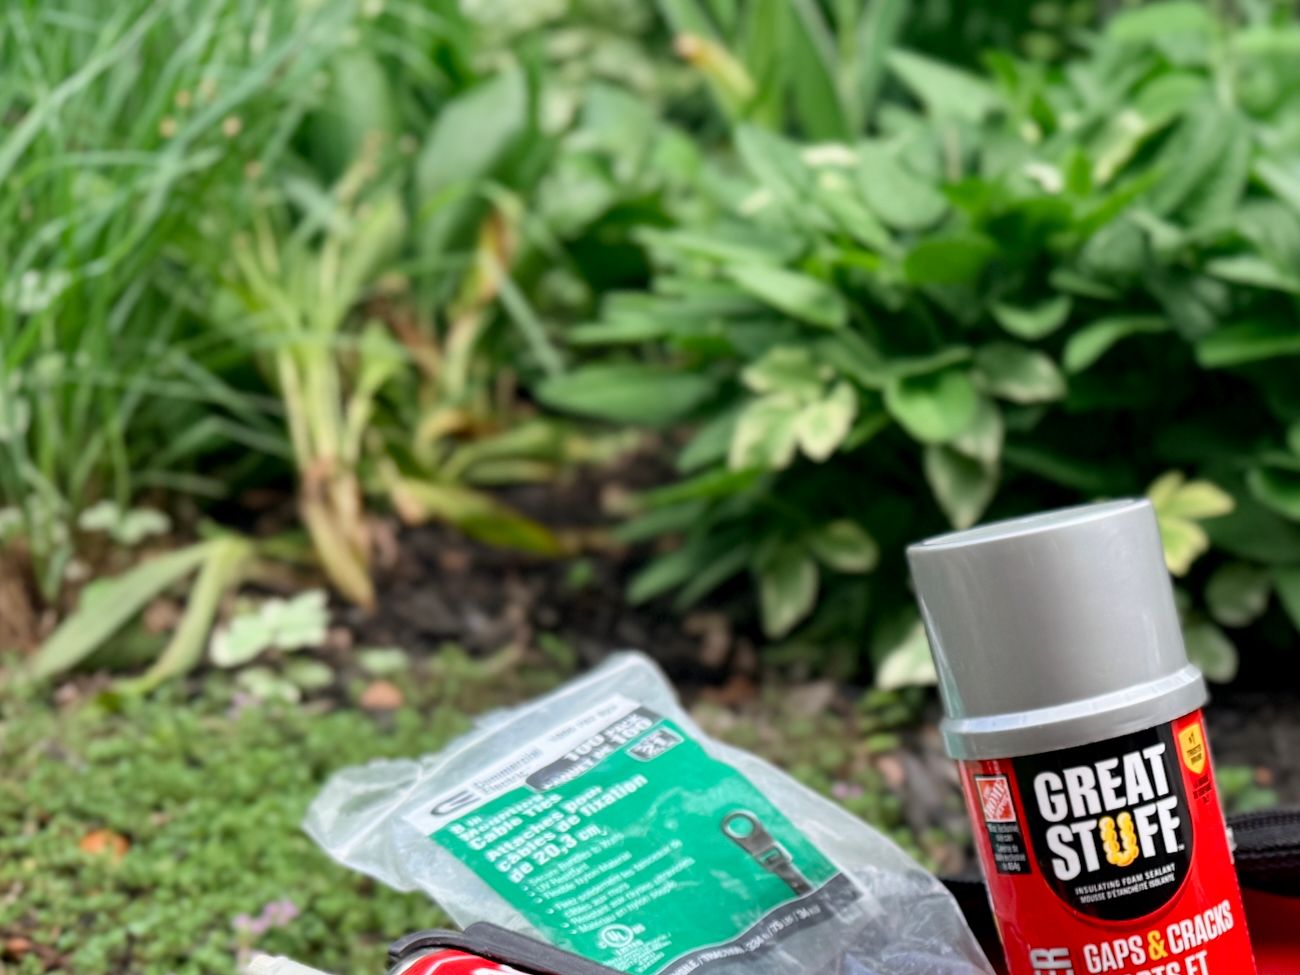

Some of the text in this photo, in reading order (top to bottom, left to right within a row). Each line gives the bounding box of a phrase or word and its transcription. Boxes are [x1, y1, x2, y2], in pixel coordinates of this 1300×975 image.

[554, 813, 581, 831] de
[579, 774, 648, 817] fixation
[1033, 743, 1169, 822] GREAT
[468, 792, 563, 850] Cable Ties
[484, 785, 605, 860] Attaches pour
[1045, 796, 1181, 881] STUFF
[506, 862, 535, 881] de
[531, 834, 578, 865] 20,3
[1075, 863, 1175, 895] INSULATING FOAM SEALANT
[1080, 892, 1106, 904] MOUSSE
[1149, 873, 1175, 889] ISOLANTE
[1083, 899, 1234, 974] GAPS & CRACKS
